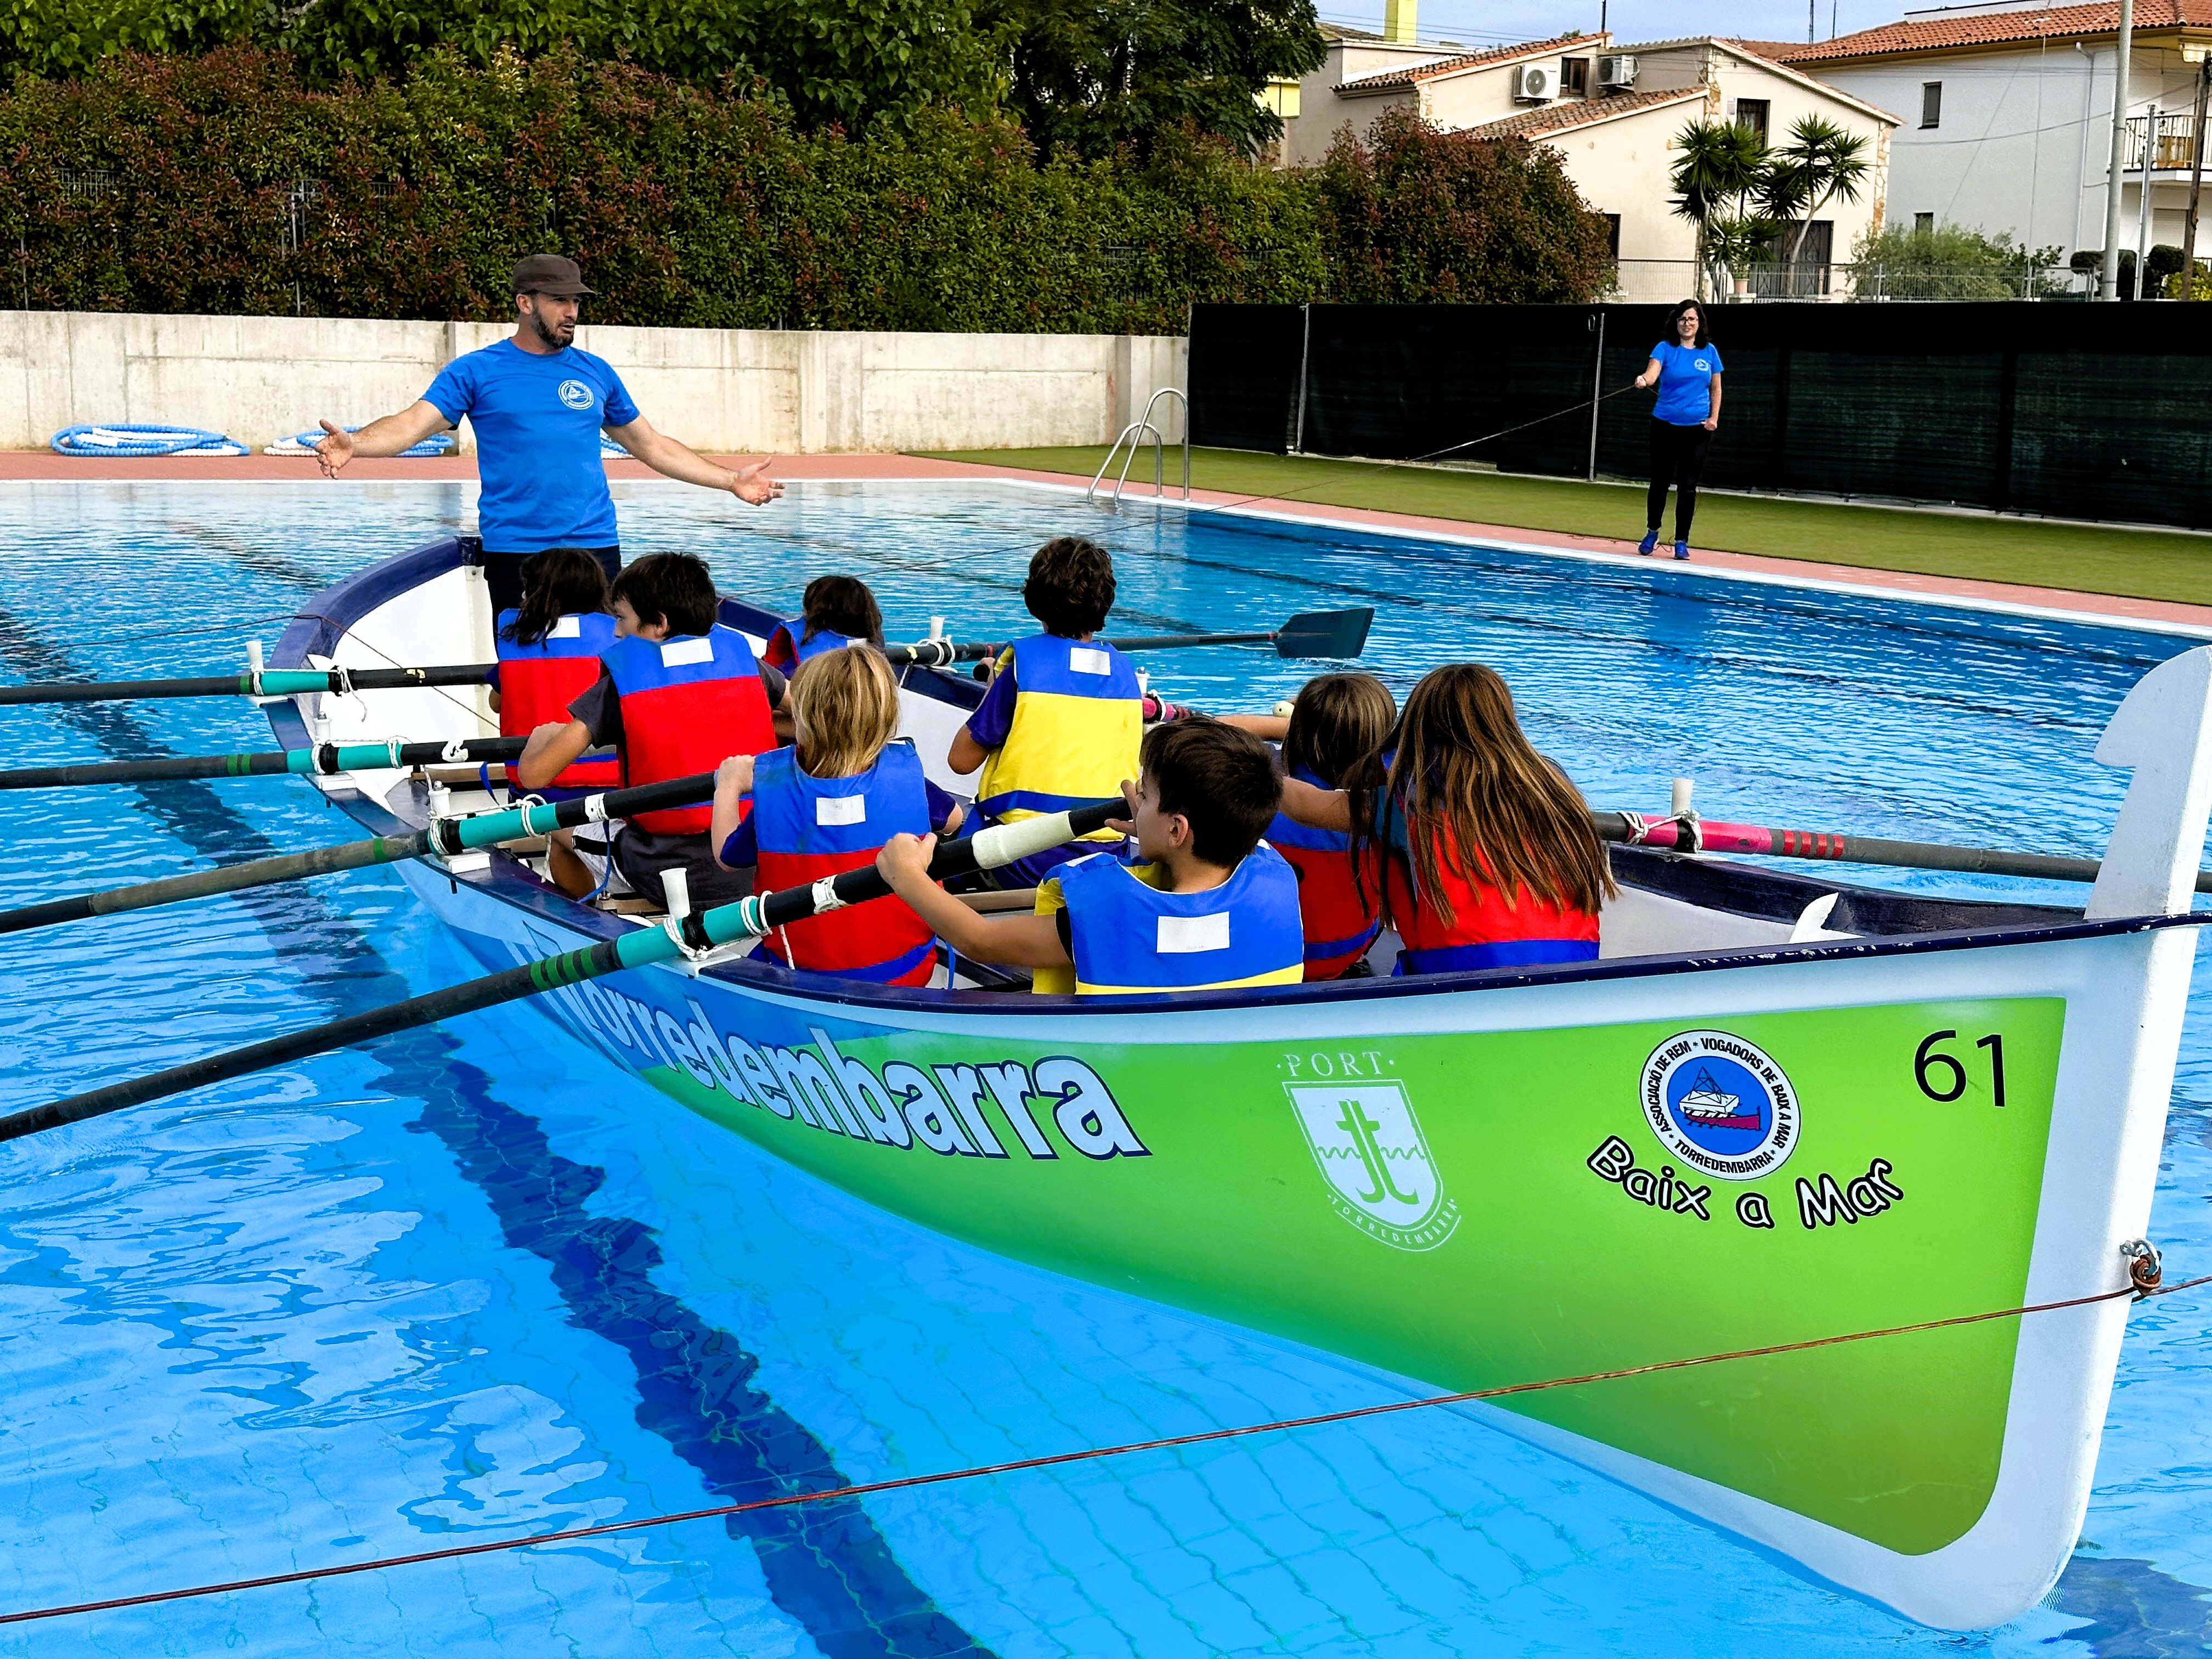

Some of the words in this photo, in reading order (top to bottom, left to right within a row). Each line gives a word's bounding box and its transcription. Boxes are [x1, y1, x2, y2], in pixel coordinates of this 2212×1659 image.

[1283, 1051, 1383, 1077] PORT
[1655, 1054, 1671, 1072] DE
[1666, 1040, 1692, 1061] REM
[1700, 1037, 1764, 1070] VOGADORS
[1760, 1066, 1779, 1085] DE
[1914, 1029, 2005, 1107] 61
[1647, 1069, 1672, 1133] ASSOCIACIÓ
[1771, 1084, 1791, 1111] BAIX
[1771, 1123, 1791, 1150] MAR
[1674, 1139, 1775, 1174] TORREDEMBARRA
[1587, 1135, 1712, 1221] Baix
[1735, 1192, 1775, 1229] a
[1795, 1158, 1904, 1230] Mar
[1331, 1197, 1458, 1244] TORREDEMBARRA
